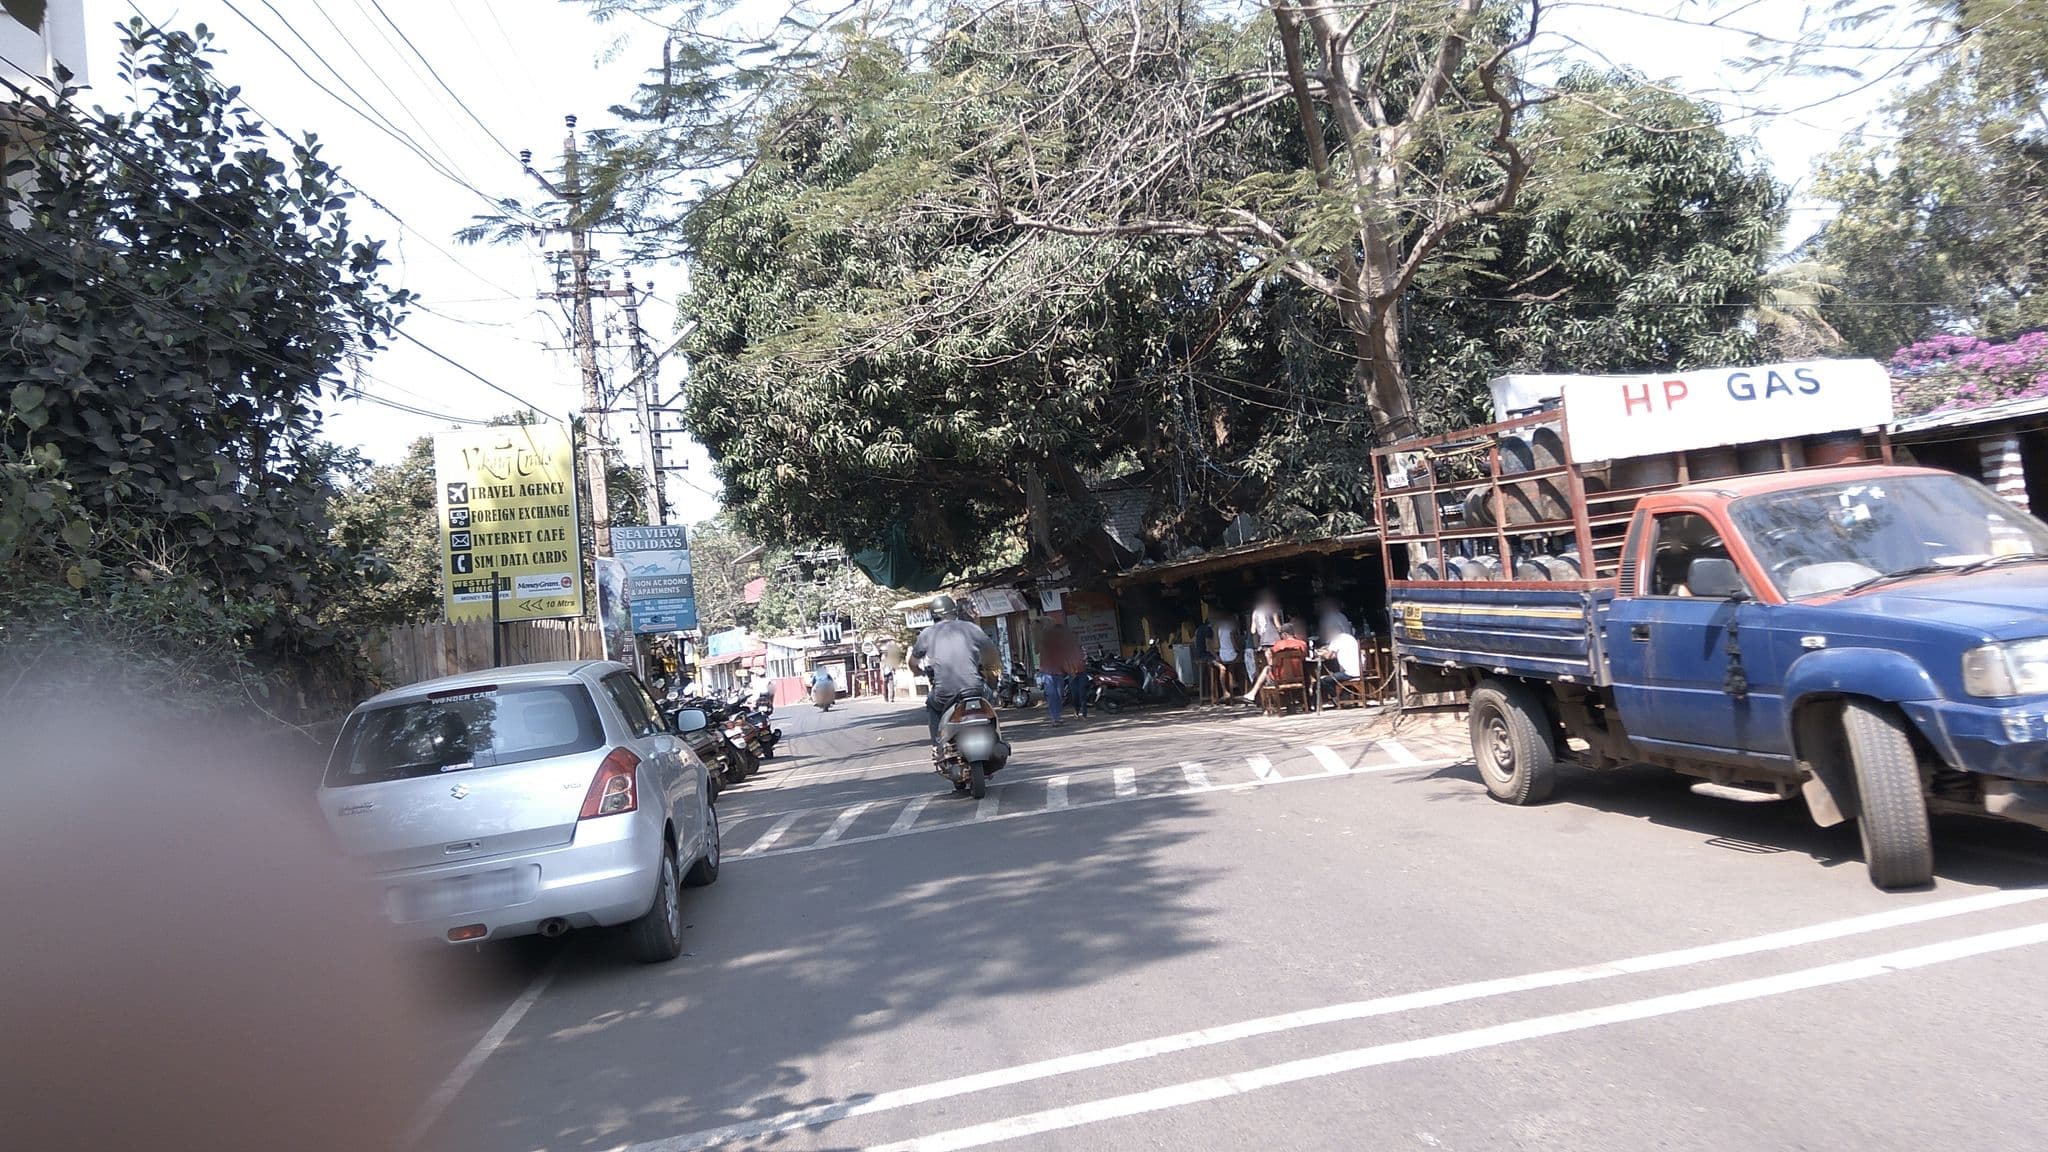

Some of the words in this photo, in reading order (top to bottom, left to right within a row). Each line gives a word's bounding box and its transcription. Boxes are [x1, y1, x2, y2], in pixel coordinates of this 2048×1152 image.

[1623, 380, 1689, 416] HP
[1727, 368, 1821, 402] GAS
[470, 485, 516, 500] TRAVEL
[519, 482, 564, 497] AGENCY
[472, 508, 516, 524] FOREIGN
[518, 505, 570, 520] EXCHANGE
[472, 531, 533, 548] INTERNET
[537, 526, 565, 543] CAFÉ
[616, 529, 642, 539] SEA
[645, 528, 680, 538] VIEW
[616, 538, 682, 550] HOLIDAYS
[474, 555, 494, 569] SIM
[501, 552, 529, 567] DATA
[532, 550, 568, 565] CARDS
[453, 578, 501, 588] WESTER
[468, 584, 501, 592] UNIO
[635, 580, 651, 588] NON
[663, 578, 688, 586] ROOMS
[637, 587, 680, 595] APARTMENTS
[546, 600, 555, 608] 10
[431, 695, 471, 704] WONDER
[473, 691, 497, 699] CARS
